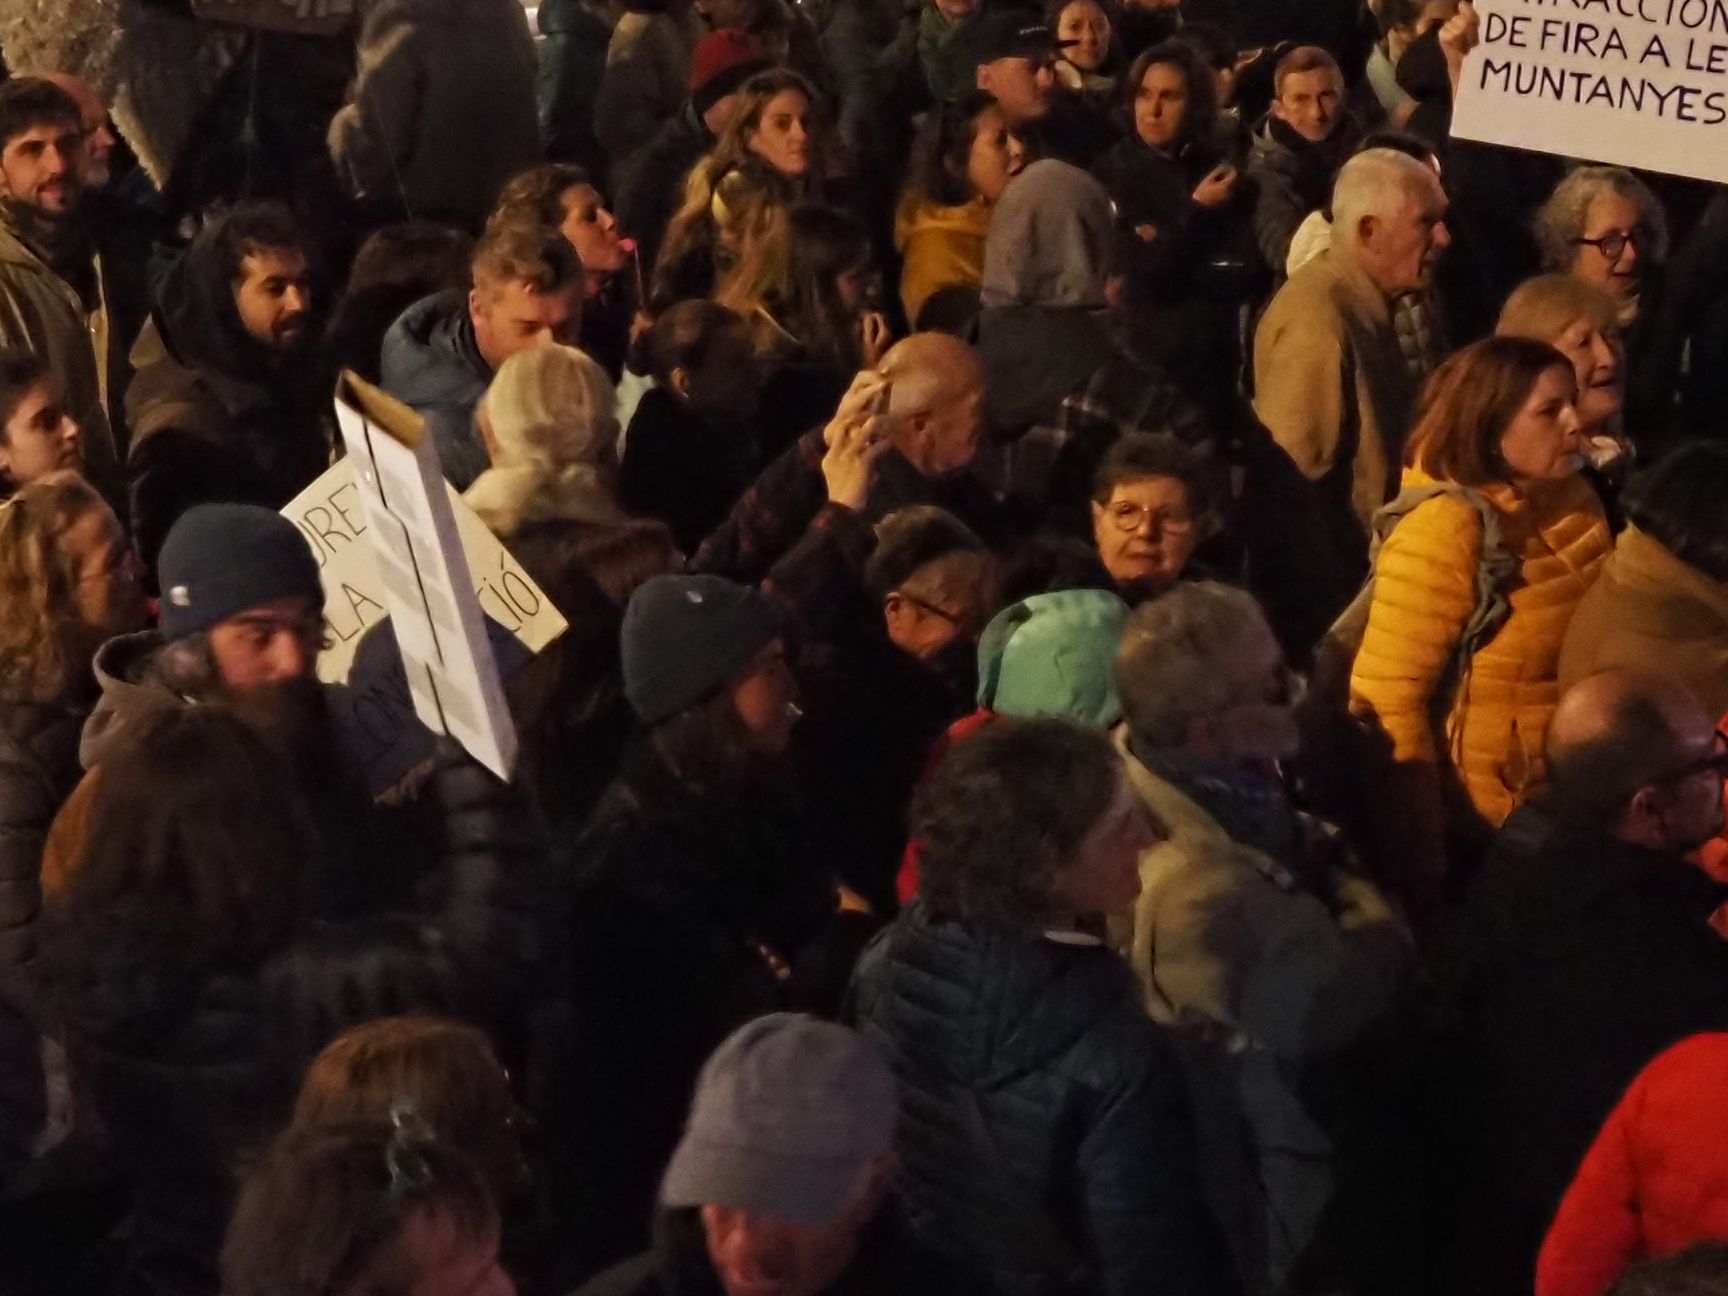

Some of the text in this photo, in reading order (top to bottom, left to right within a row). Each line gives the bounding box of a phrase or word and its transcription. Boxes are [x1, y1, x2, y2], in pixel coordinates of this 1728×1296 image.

[1485, 13, 1532, 48] DE
[1540, 19, 1628, 60] FIRA
[1640, 34, 1670, 67] A
[1480, 58, 1727, 125] MUNTANYES
